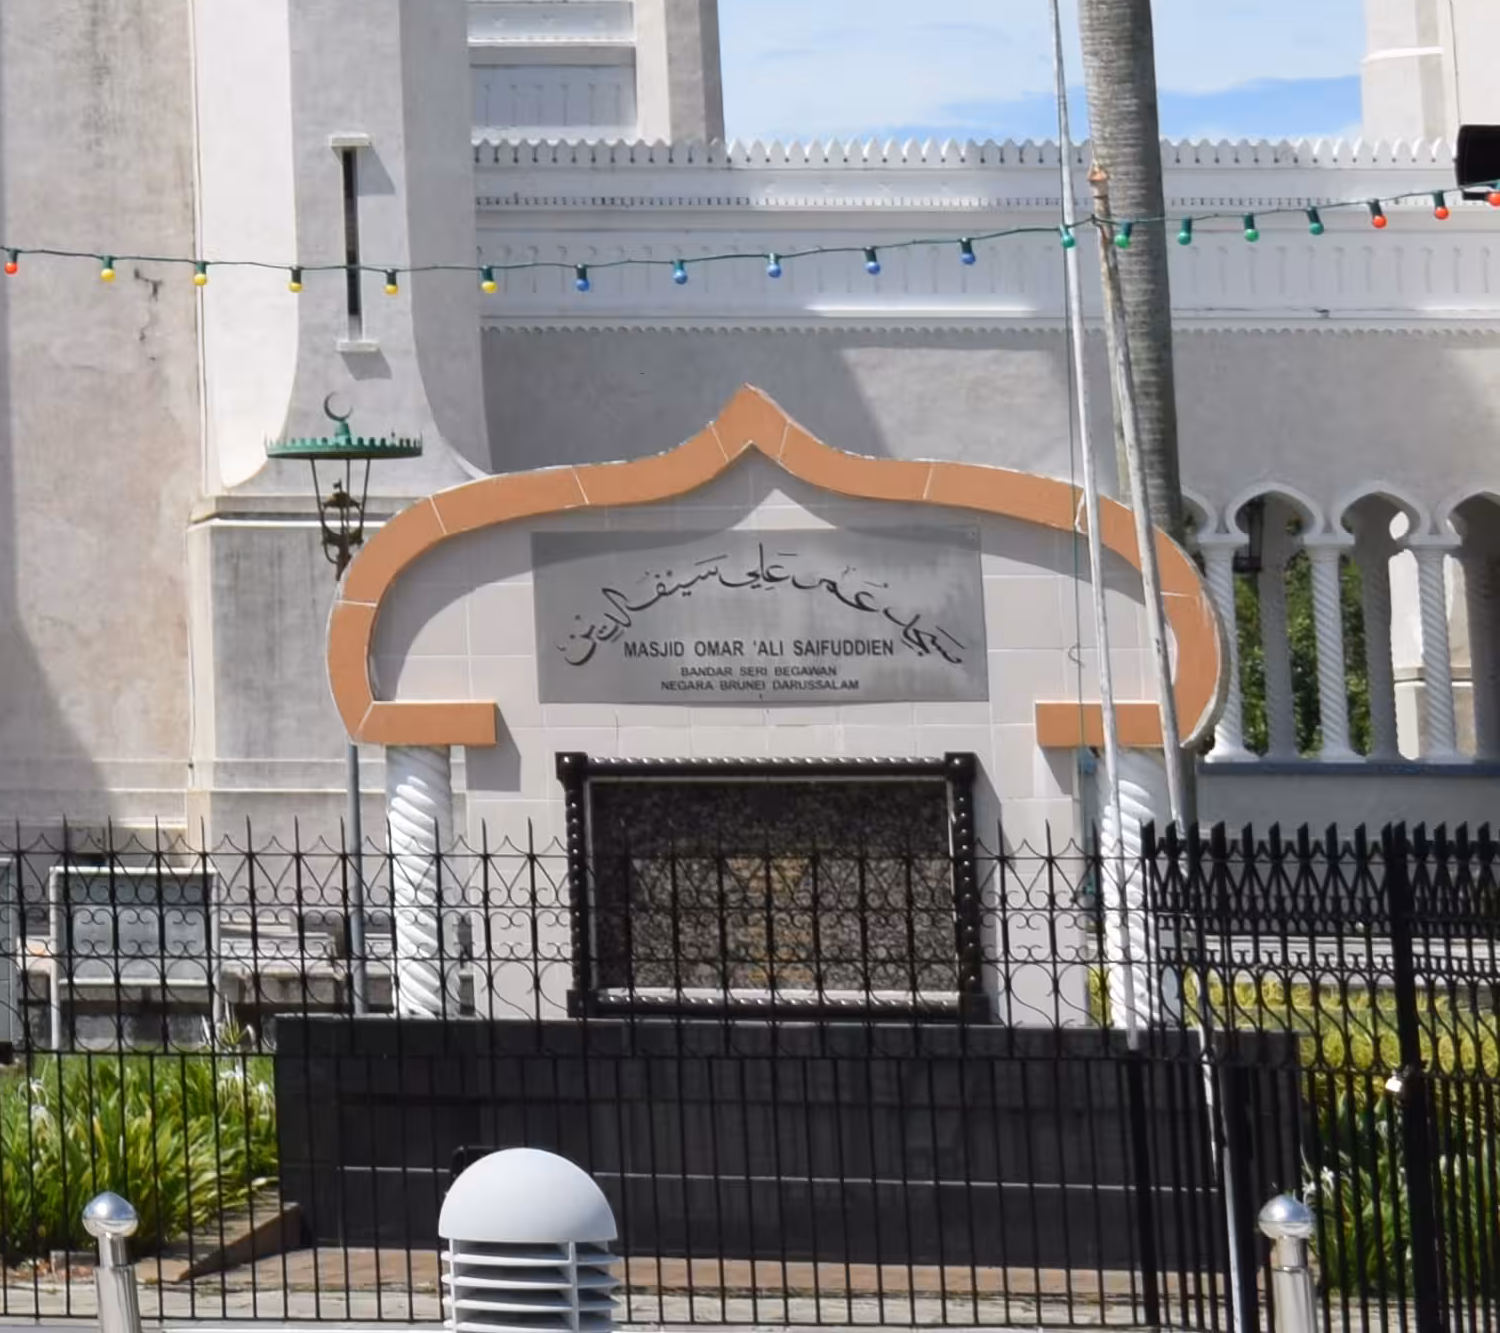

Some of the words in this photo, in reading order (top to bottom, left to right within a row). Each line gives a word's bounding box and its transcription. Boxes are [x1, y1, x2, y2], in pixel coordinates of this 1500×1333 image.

[623, 640, 685, 658] MASJID
[693, 639, 745, 657] OMAR
[792, 638, 895, 657] SAIFUDDIEN
[680, 666, 733, 677] BANDAR
[739, 666, 768, 677] SERI
[774, 666, 838, 677] BEGAWAN
[660, 680, 715, 691] NEGARA
[719, 680, 766, 691] BRUNEI
[772, 679, 860, 691] DARUSSALAM
